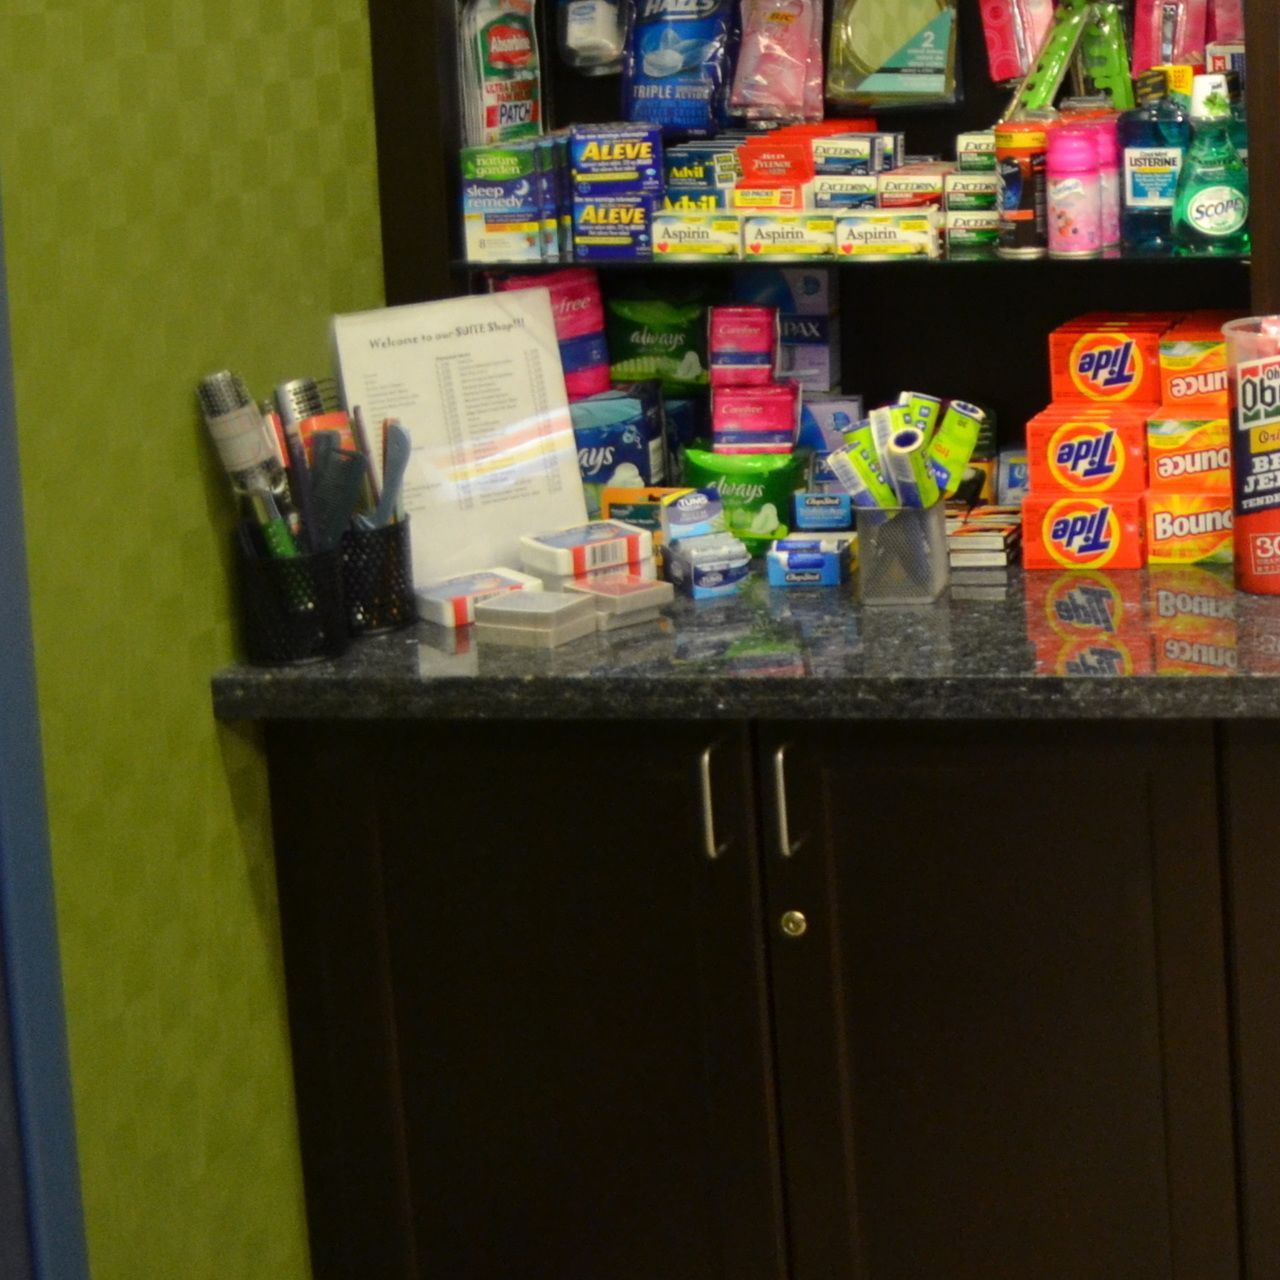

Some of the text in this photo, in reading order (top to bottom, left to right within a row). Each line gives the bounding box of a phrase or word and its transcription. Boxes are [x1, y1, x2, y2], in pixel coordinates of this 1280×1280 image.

[921, 31, 935, 48] 2
[632, 84, 673, 100] TRIPLE
[500, 103, 530, 125] PATCH
[580, 140, 653, 161] ALEVE
[814, 145, 864, 158] EXCEDRIN
[475, 154, 519, 167] nature
[1128, 156, 1179, 169] LISTERINE
[474, 165, 521, 179] garden
[669, 166, 705, 179] Advil
[466, 184, 504, 201] sleep
[819, 181, 871, 192] EXCEDRIN
[884, 181, 937, 193] EXCEDRIN
[467, 195, 523, 211] remedy
[1194, 196, 1244, 221] SCOPE
[579, 204, 646, 225] ALEVE
[661, 227, 710, 244] Aspirin
[754, 227, 805, 244] Aspirin
[845, 227, 898, 244] Aspirin
[369, 335, 418, 349] Welcome
[422, 333, 433, 342] to
[630, 326, 686, 351] always
[1077, 340, 1135, 385] Tide
[1266, 366, 1280, 380] Oh
[1056, 429, 1116, 478] Tide
[1157, 448, 1231, 478] ounce
[678, 495, 708, 509] TUMS
[1051, 507, 1111, 554] Tide
